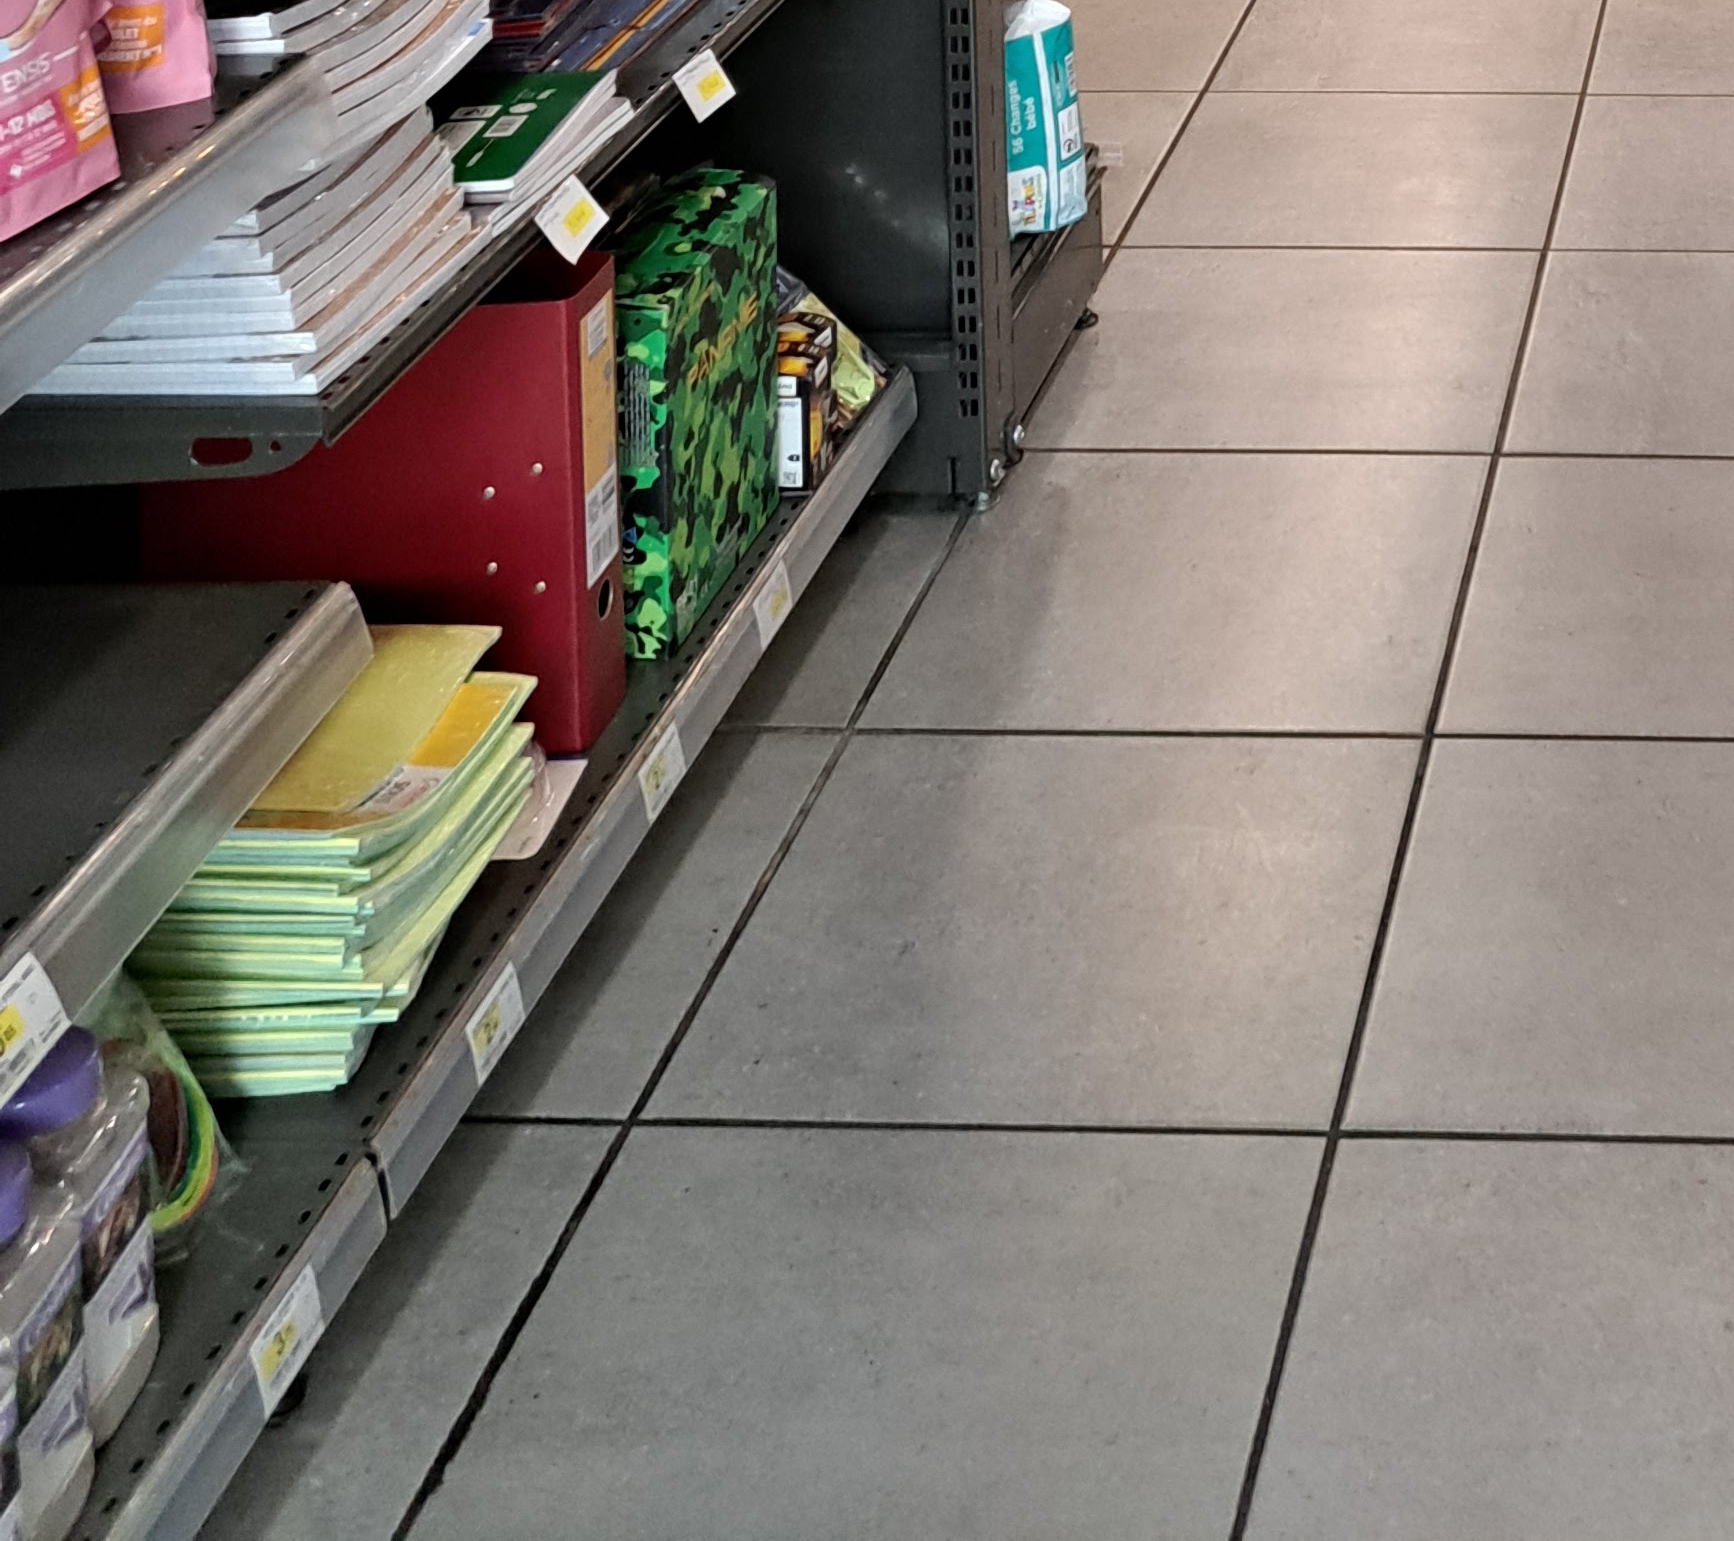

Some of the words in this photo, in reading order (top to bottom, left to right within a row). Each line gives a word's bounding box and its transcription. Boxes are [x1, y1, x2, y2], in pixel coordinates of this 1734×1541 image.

[1007, 79, 1023, 136] Changes
[1023, 96, 1037, 131] bébé
[1012, 137, 1025, 155] 56
